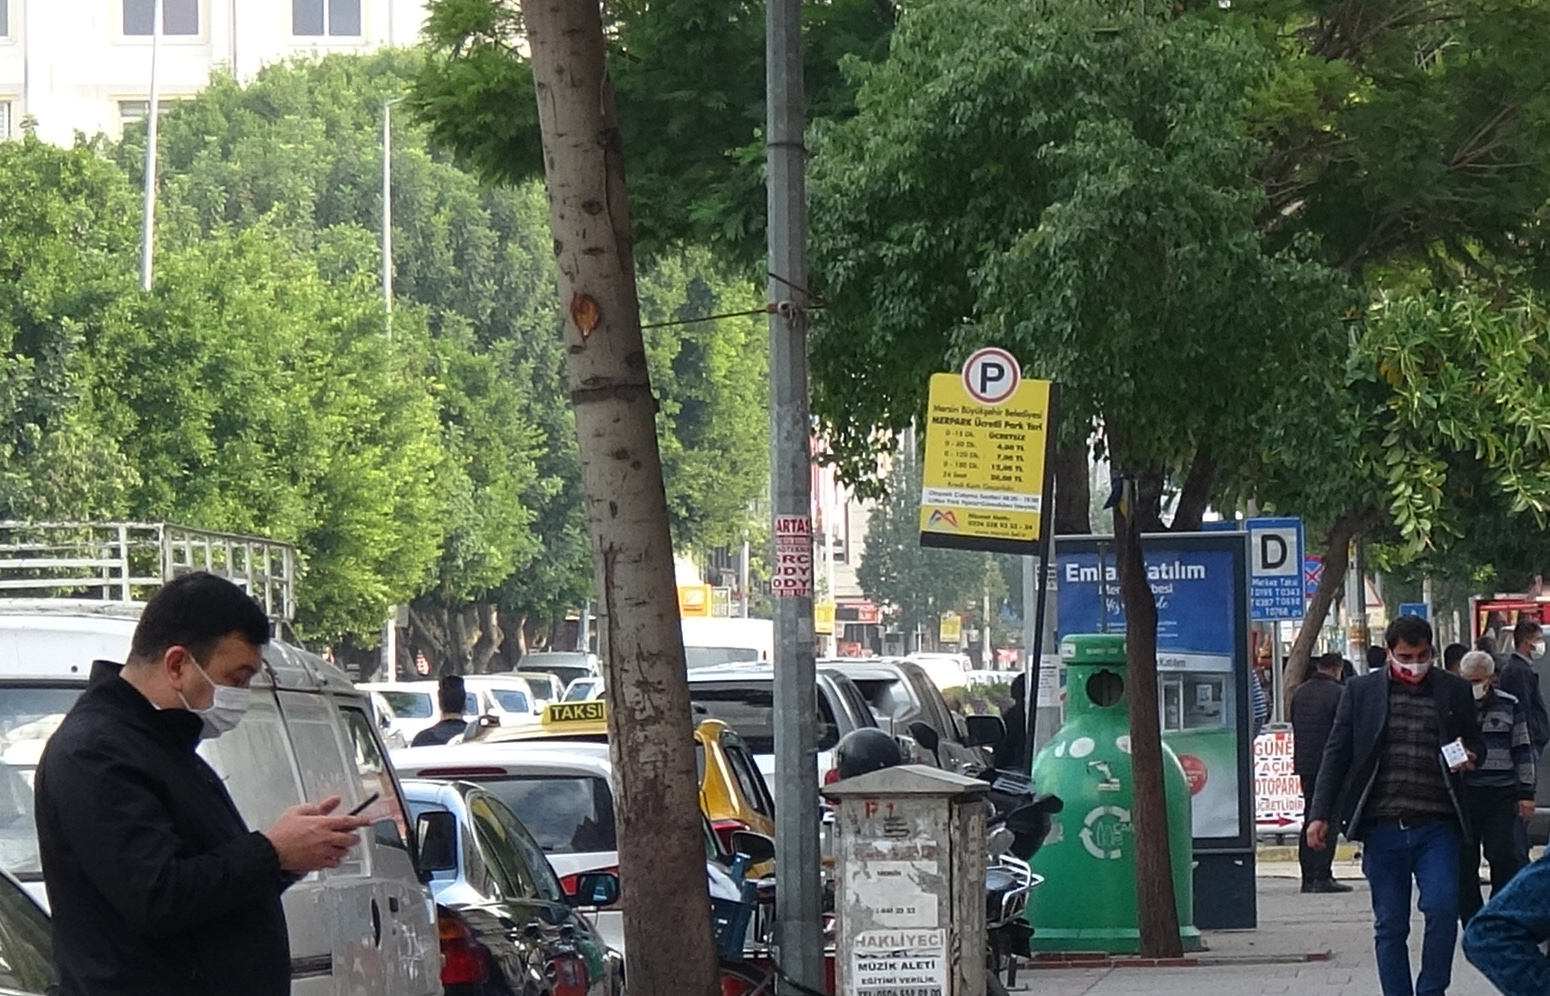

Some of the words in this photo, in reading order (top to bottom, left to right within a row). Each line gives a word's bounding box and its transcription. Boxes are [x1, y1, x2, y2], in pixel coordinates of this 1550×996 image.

[980, 362, 1005, 393] P
[932, 416, 972, 426] MERPARK
[1004, 420, 1024, 430] Park
[1261, 534, 1288, 570] D
[858, 961, 898, 972] MÜZİK
[901, 959, 936, 971] ALETİ
